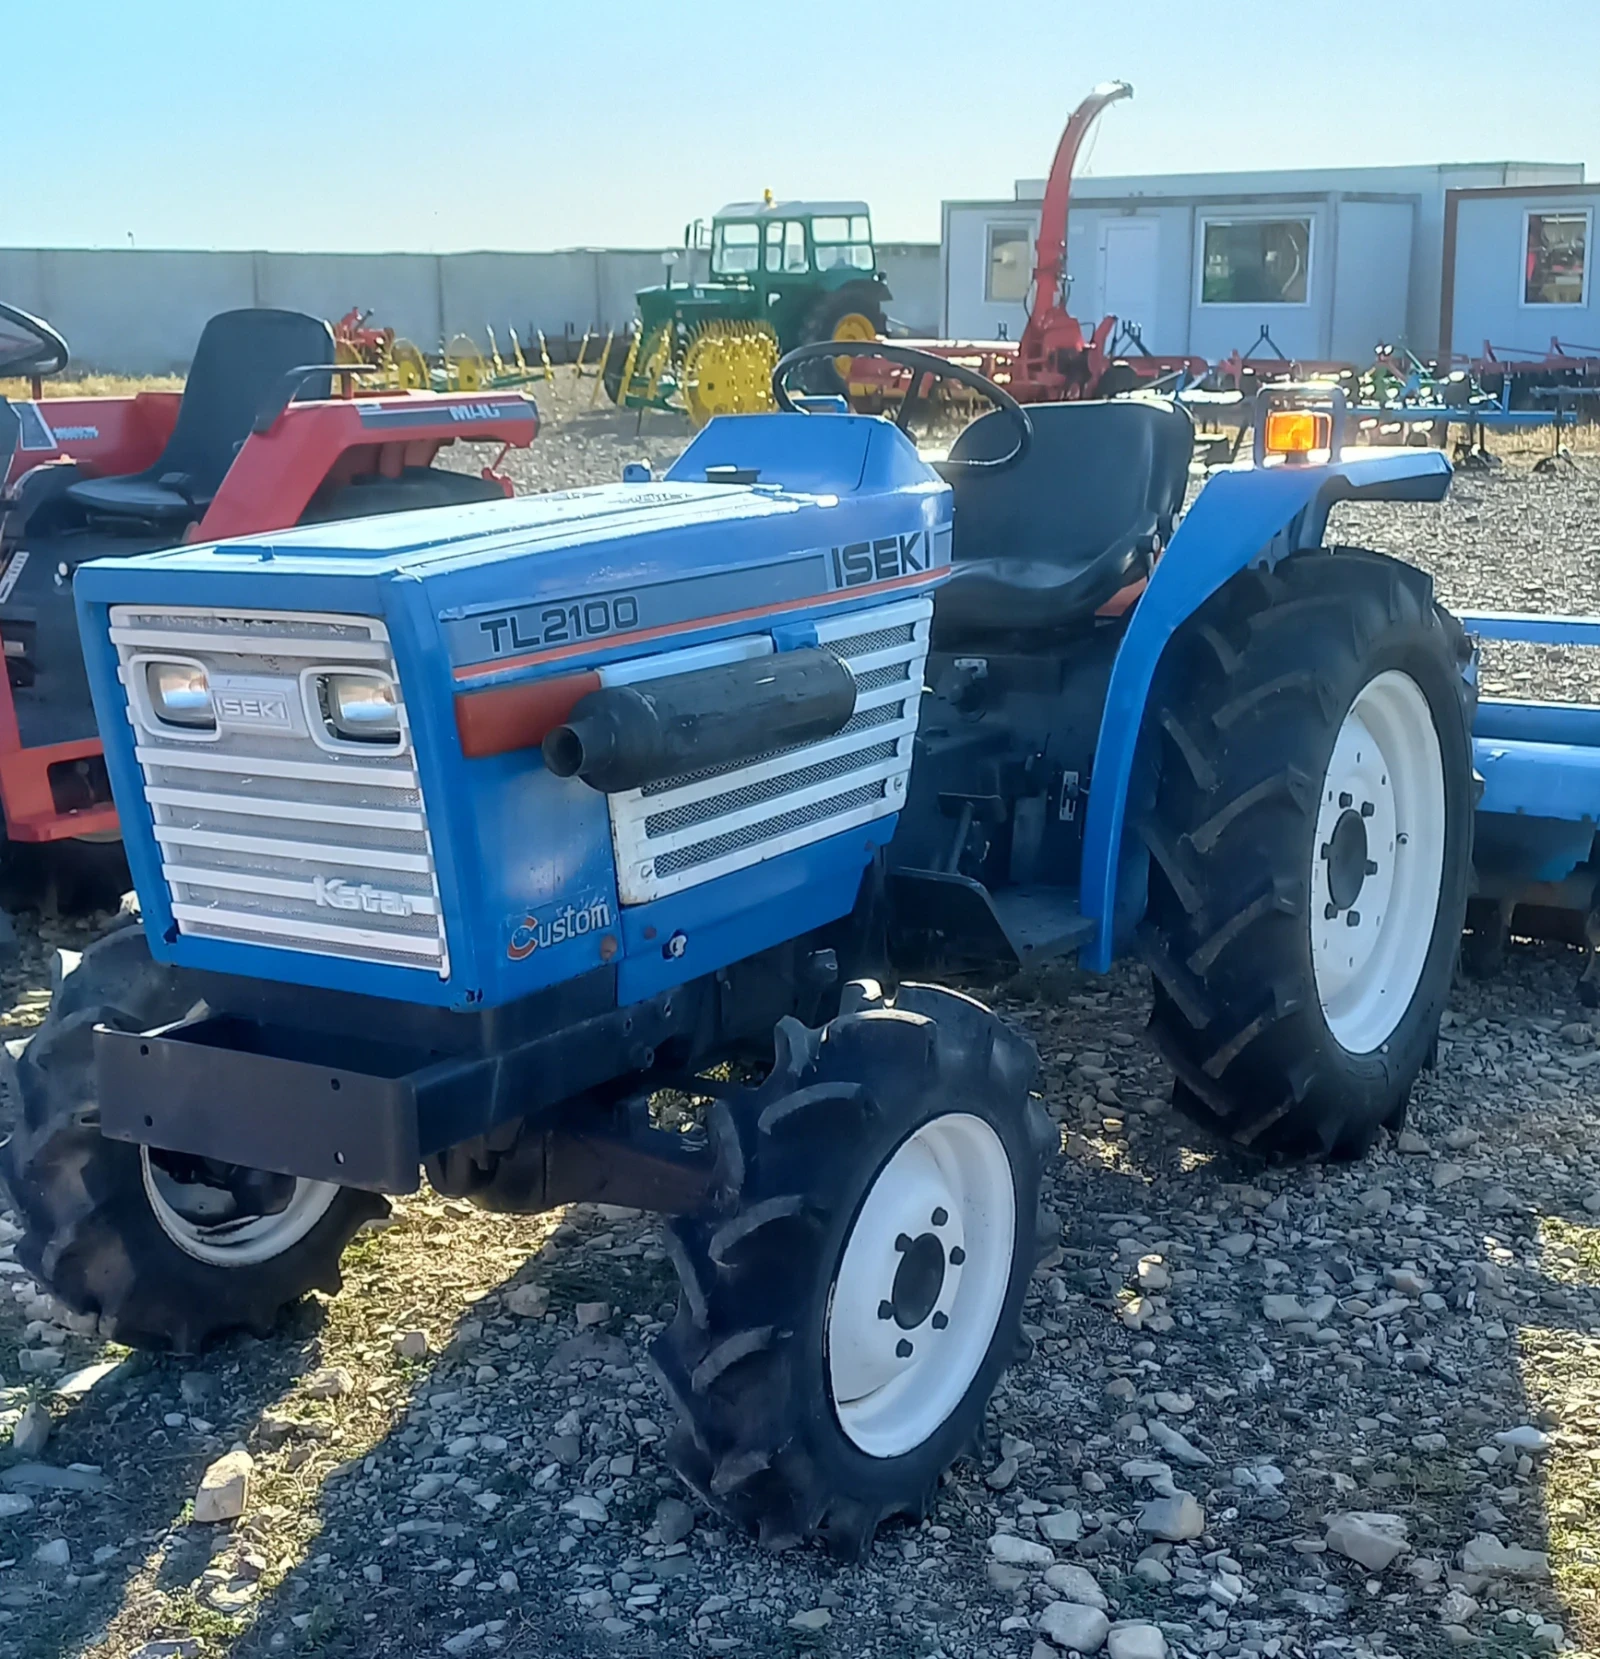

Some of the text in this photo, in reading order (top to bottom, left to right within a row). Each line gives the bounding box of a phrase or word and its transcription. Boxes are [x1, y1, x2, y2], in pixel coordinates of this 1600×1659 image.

[831, 530, 931, 589] ISEKI
[480, 596, 638, 653] TL2100
[215, 698, 286, 719] ISEKI
[507, 903, 611, 960] Custom
